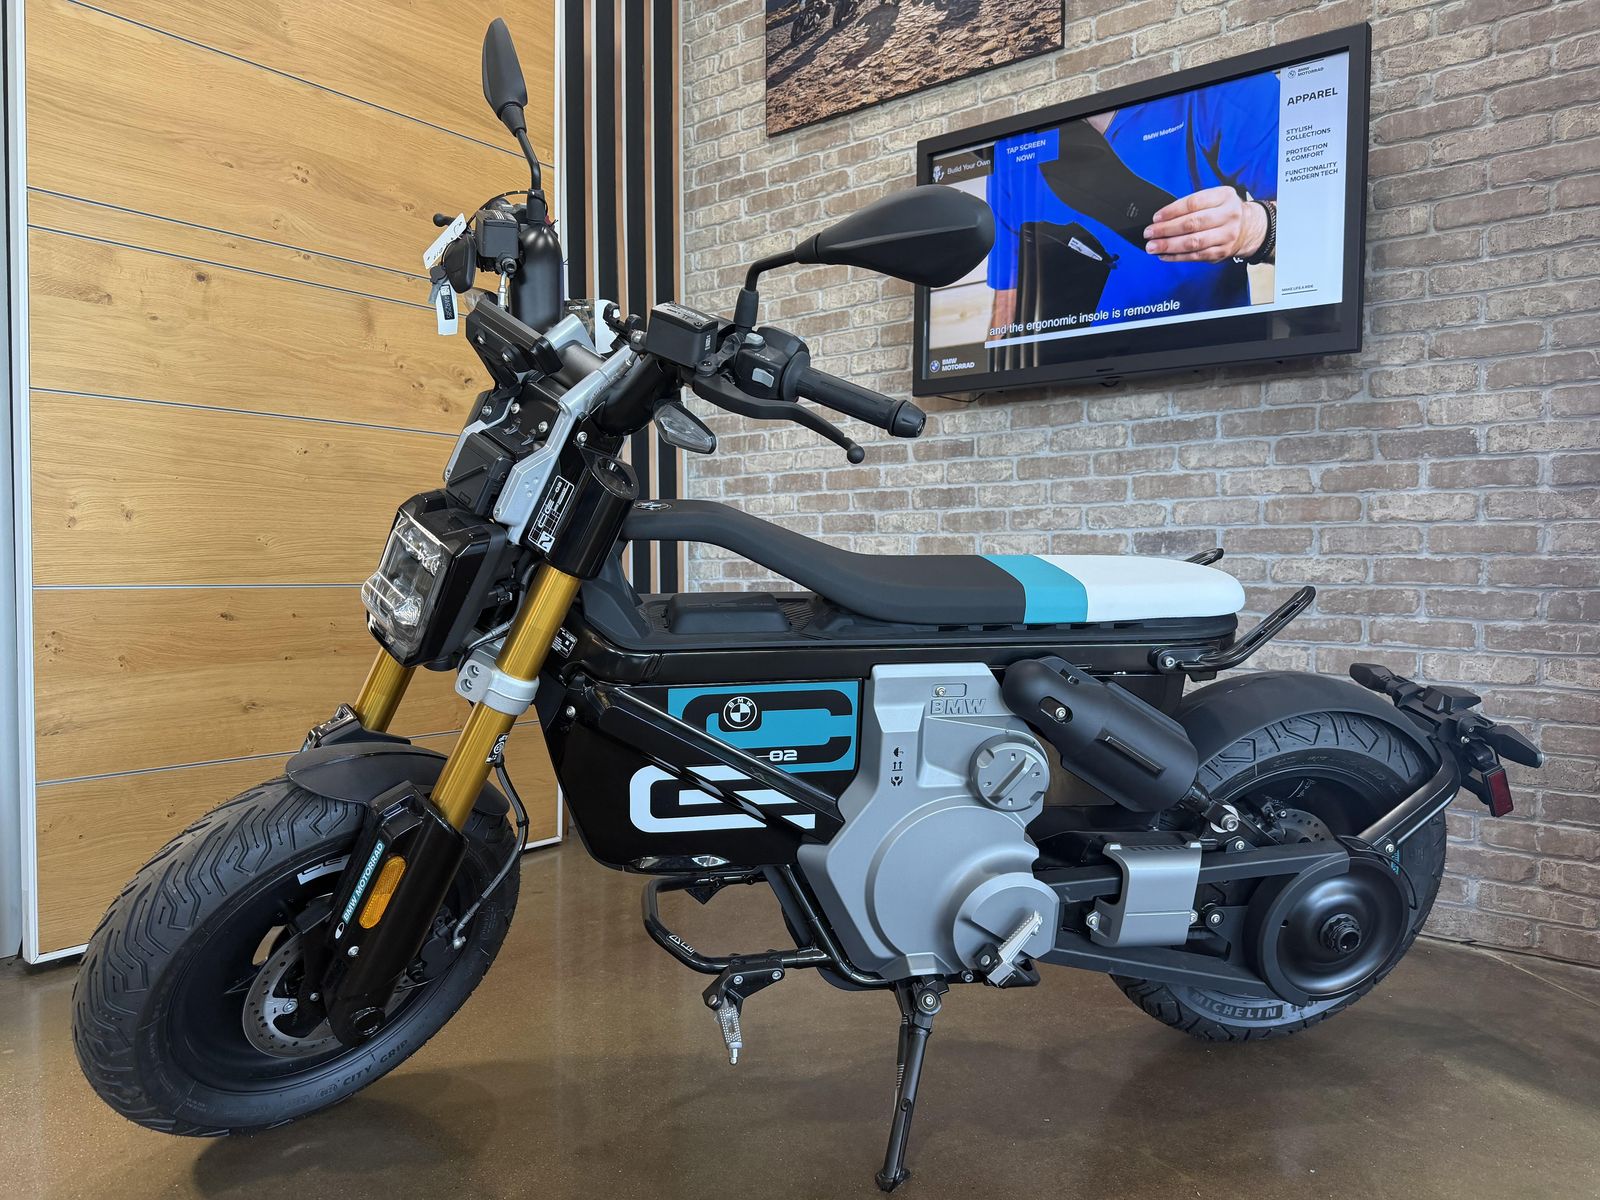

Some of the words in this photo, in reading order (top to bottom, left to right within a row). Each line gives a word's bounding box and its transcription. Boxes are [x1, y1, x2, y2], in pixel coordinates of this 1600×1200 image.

[1287, 87, 1338, 106] APPAREL
[1286, 125, 1313, 135] STYLISH
[1286, 127, 1331, 142] COLLECTIONS
[1006, 145, 1019, 155] TAP
[1019, 139, 1046, 151] SCREEN
[1286, 142, 1328, 156] PROTECTION
[1016, 152, 1036, 163] NOW!
[1291, 150, 1324, 162] COMFORT
[947, 164, 962, 175] Build
[962, 161, 976, 171] Your
[976, 159, 991, 168] Own
[1285, 161, 1338, 176] FUNCTIONALITY
[1290, 172, 1320, 183] MODERN
[1320, 168, 1339, 177] TECH
[989, 323, 1007, 336] and
[1009, 319, 1024, 333] the
[1026, 314, 1077, 332] ergonomic
[1079, 310, 1109, 323] insole
[1112, 307, 1121, 319] is
[1123, 299, 1180, 317] removable
[942, 361, 975, 371] MOTORRAD
[930, 698, 987, 715] BMW
[343, 896, 357, 922] BMW
[354, 842, 383, 898] MOTORRAD
[1190, 992, 1278, 1018] MICHELIN
[342, 1064, 373, 1086] CITY
[379, 1038, 408, 1064] GRIP
